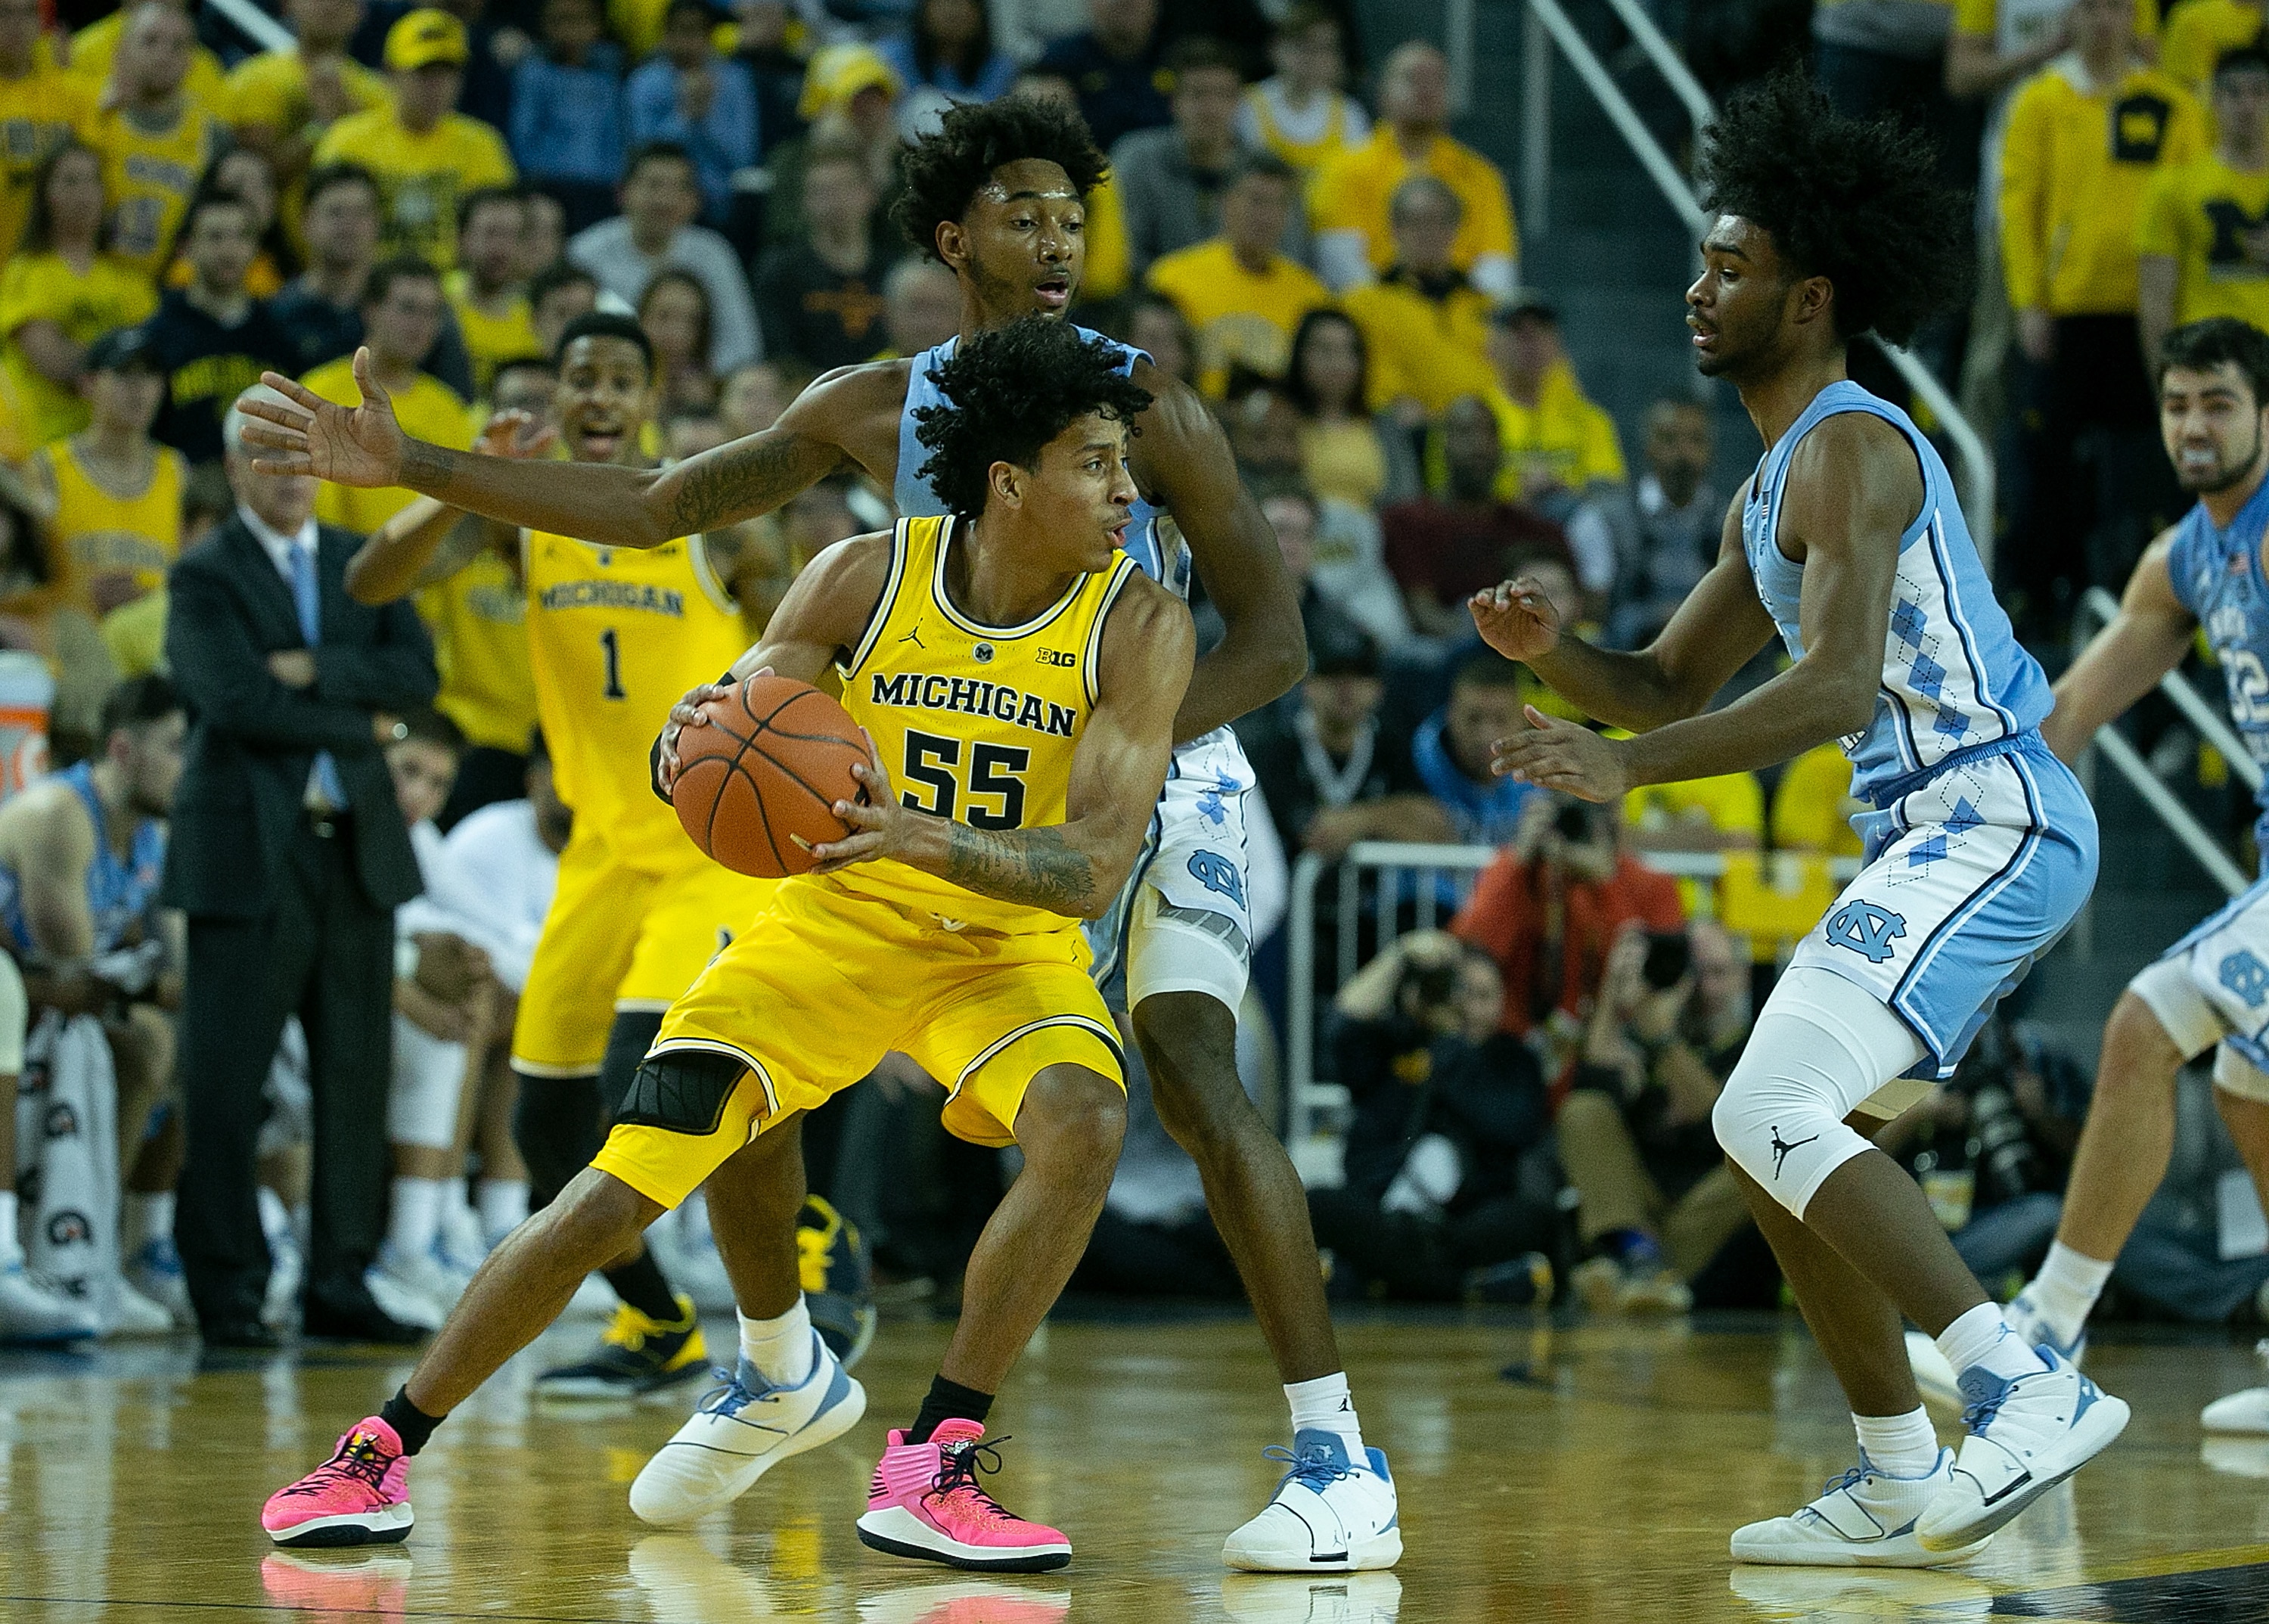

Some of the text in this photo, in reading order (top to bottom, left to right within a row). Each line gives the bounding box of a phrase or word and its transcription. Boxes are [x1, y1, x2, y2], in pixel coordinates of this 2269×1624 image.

[539, 579, 683, 619] MICHIGAN
[600, 628, 626, 700] 1
[871, 673, 1076, 738] MICHIGAN
[901, 727, 1032, 831] 55
